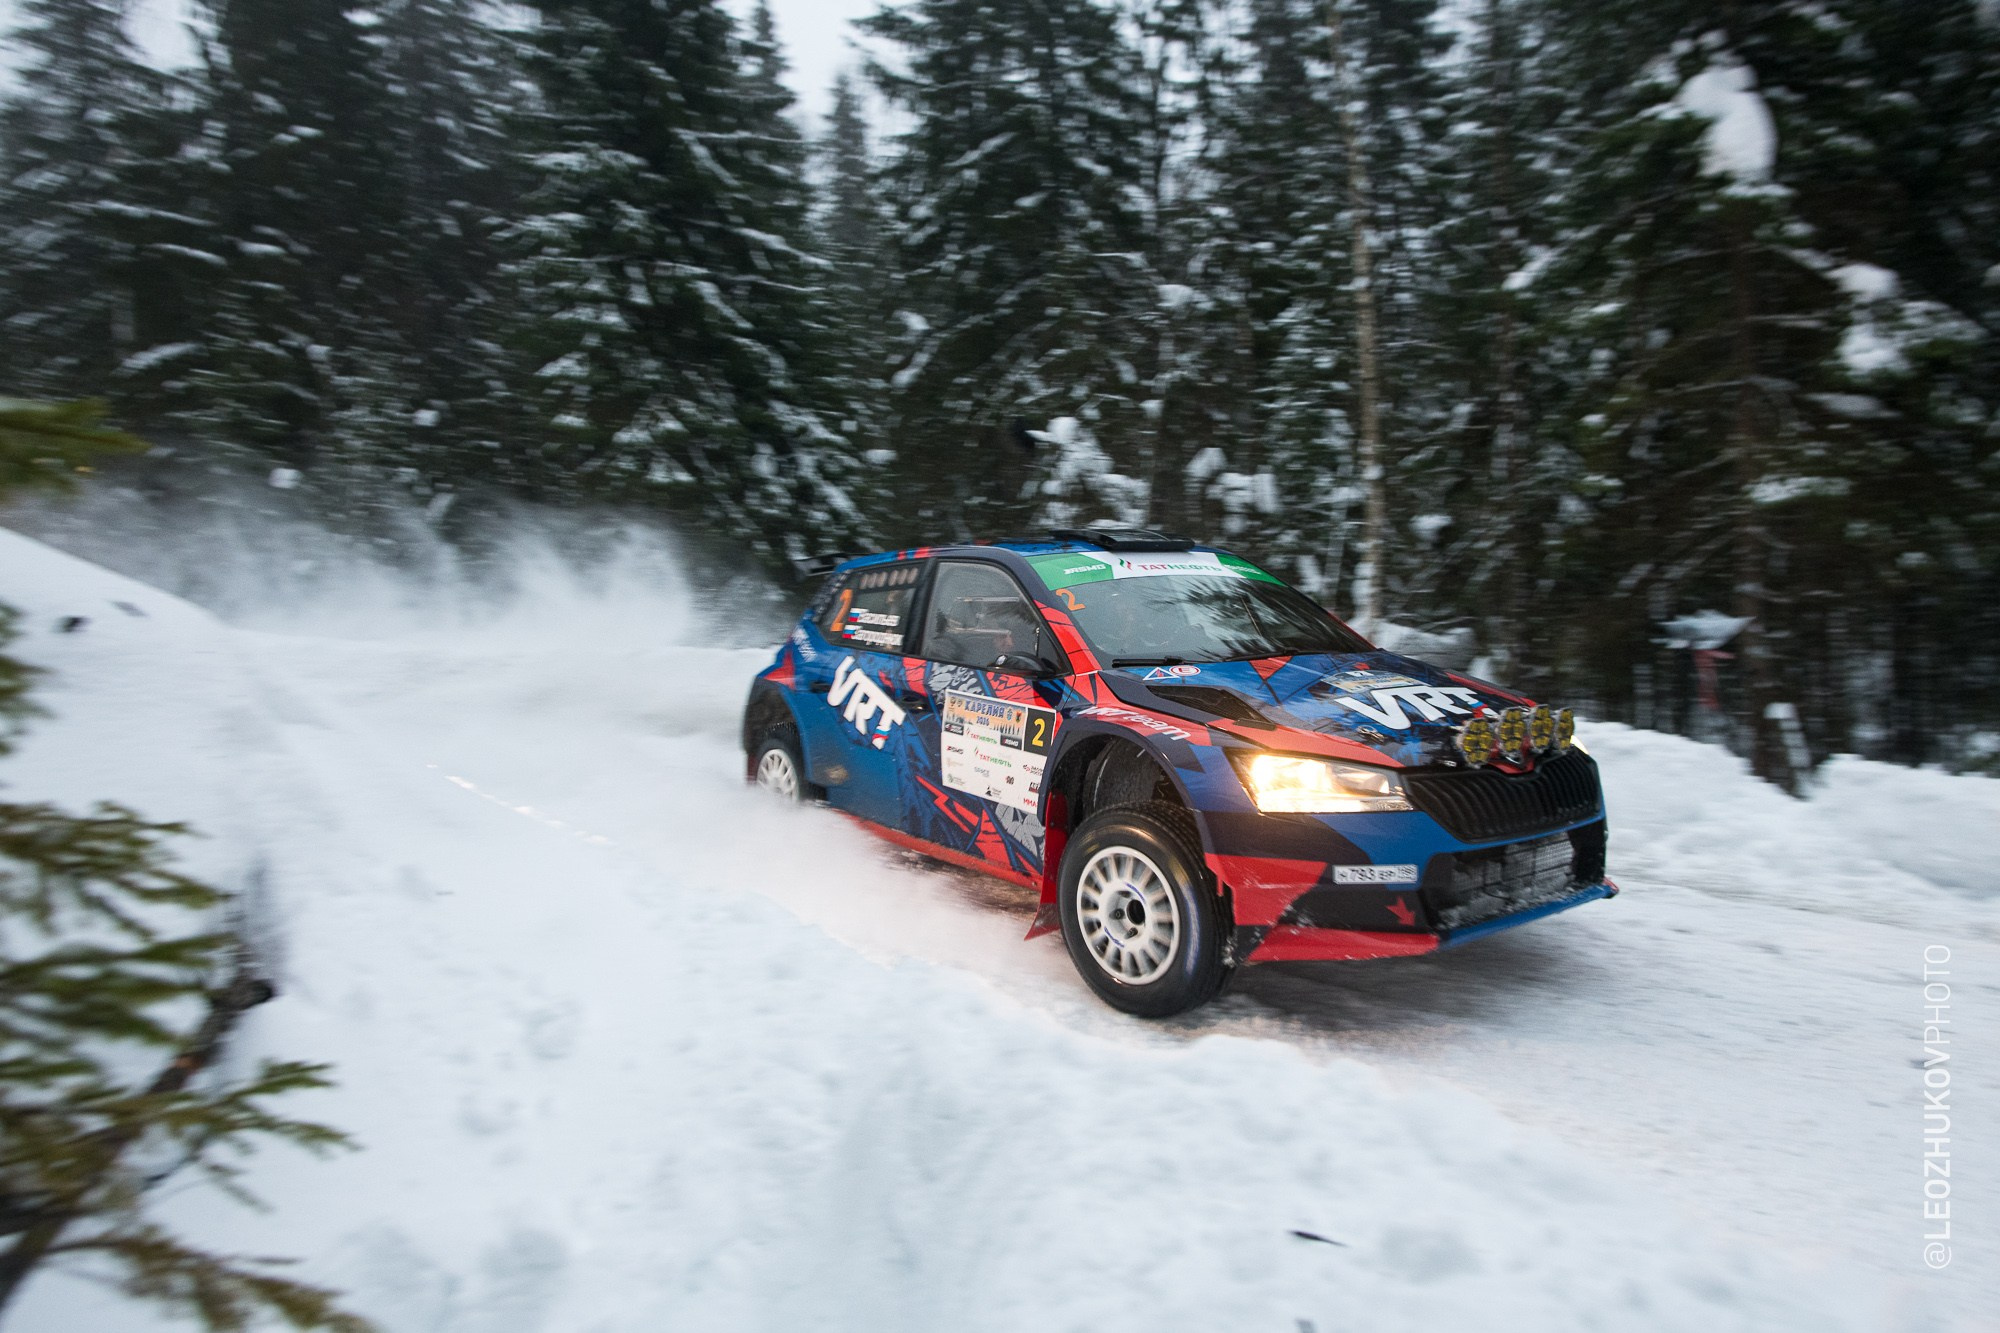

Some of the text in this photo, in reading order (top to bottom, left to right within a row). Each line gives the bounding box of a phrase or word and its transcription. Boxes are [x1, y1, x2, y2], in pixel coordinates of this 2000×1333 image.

[1138, 563, 1223, 573] ТАТНЕФТЬ
[830, 589, 853, 632] 2
[1055, 588, 1086, 612] 2
[826, 655, 908, 751] VRT
[964, 700, 1005, 719] КАРЕЛИЯ
[1333, 685, 1499, 731] VRT
[970, 733, 998, 745] ТАТНЕФТЬ
[1031, 717, 1047, 748] 2
[1123, 714, 1192, 741] team
[979, 754, 1012, 768] ТАТНЕФТЬ
